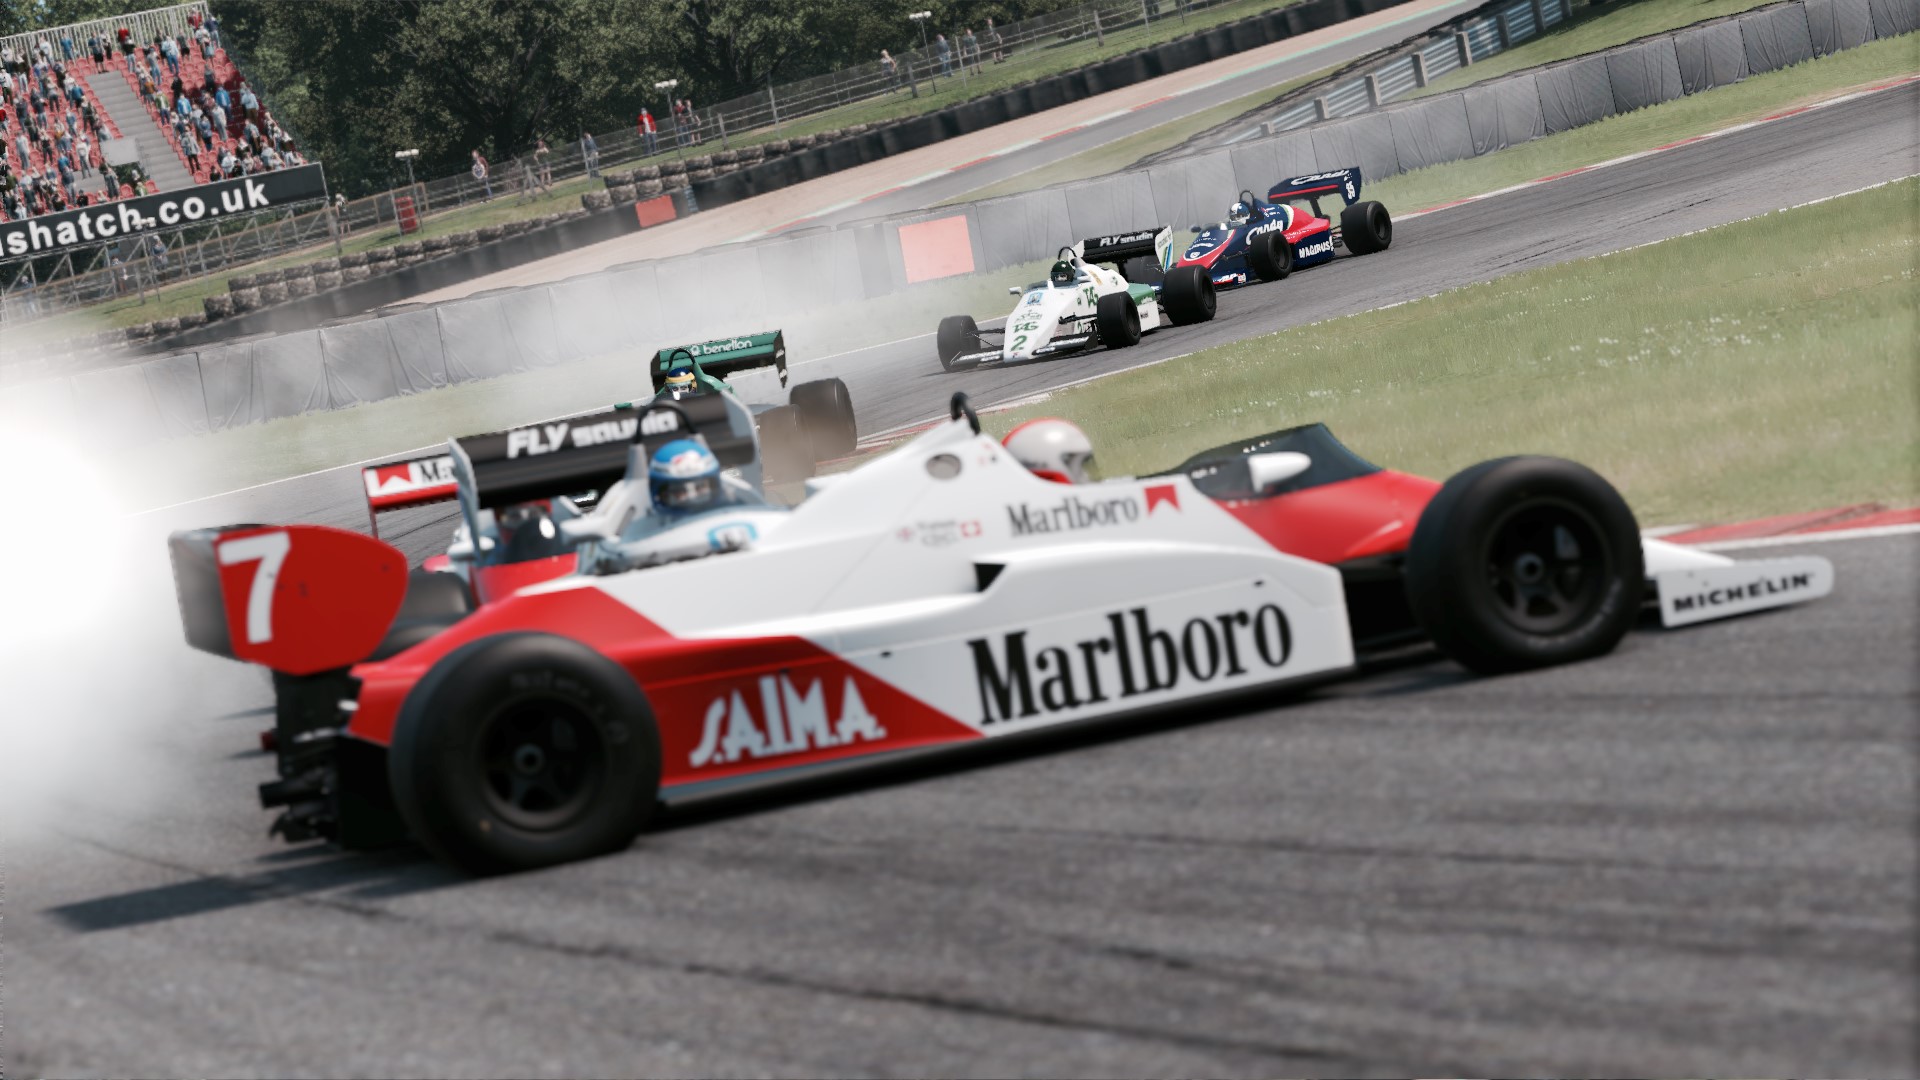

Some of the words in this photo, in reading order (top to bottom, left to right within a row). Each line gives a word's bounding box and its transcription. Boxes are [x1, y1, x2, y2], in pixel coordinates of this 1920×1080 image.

[0, 178, 269, 257] shatch.co.uk
[1100, 234, 1121, 247] FLY
[1010, 335, 1027, 351] 2
[507, 422, 569, 459] FLY
[1006, 496, 1139, 538] Marlboro
[218, 531, 291, 645] 7
[1673, 573, 1809, 612] MICHELIN
[966, 603, 1293, 726] Marlboro
